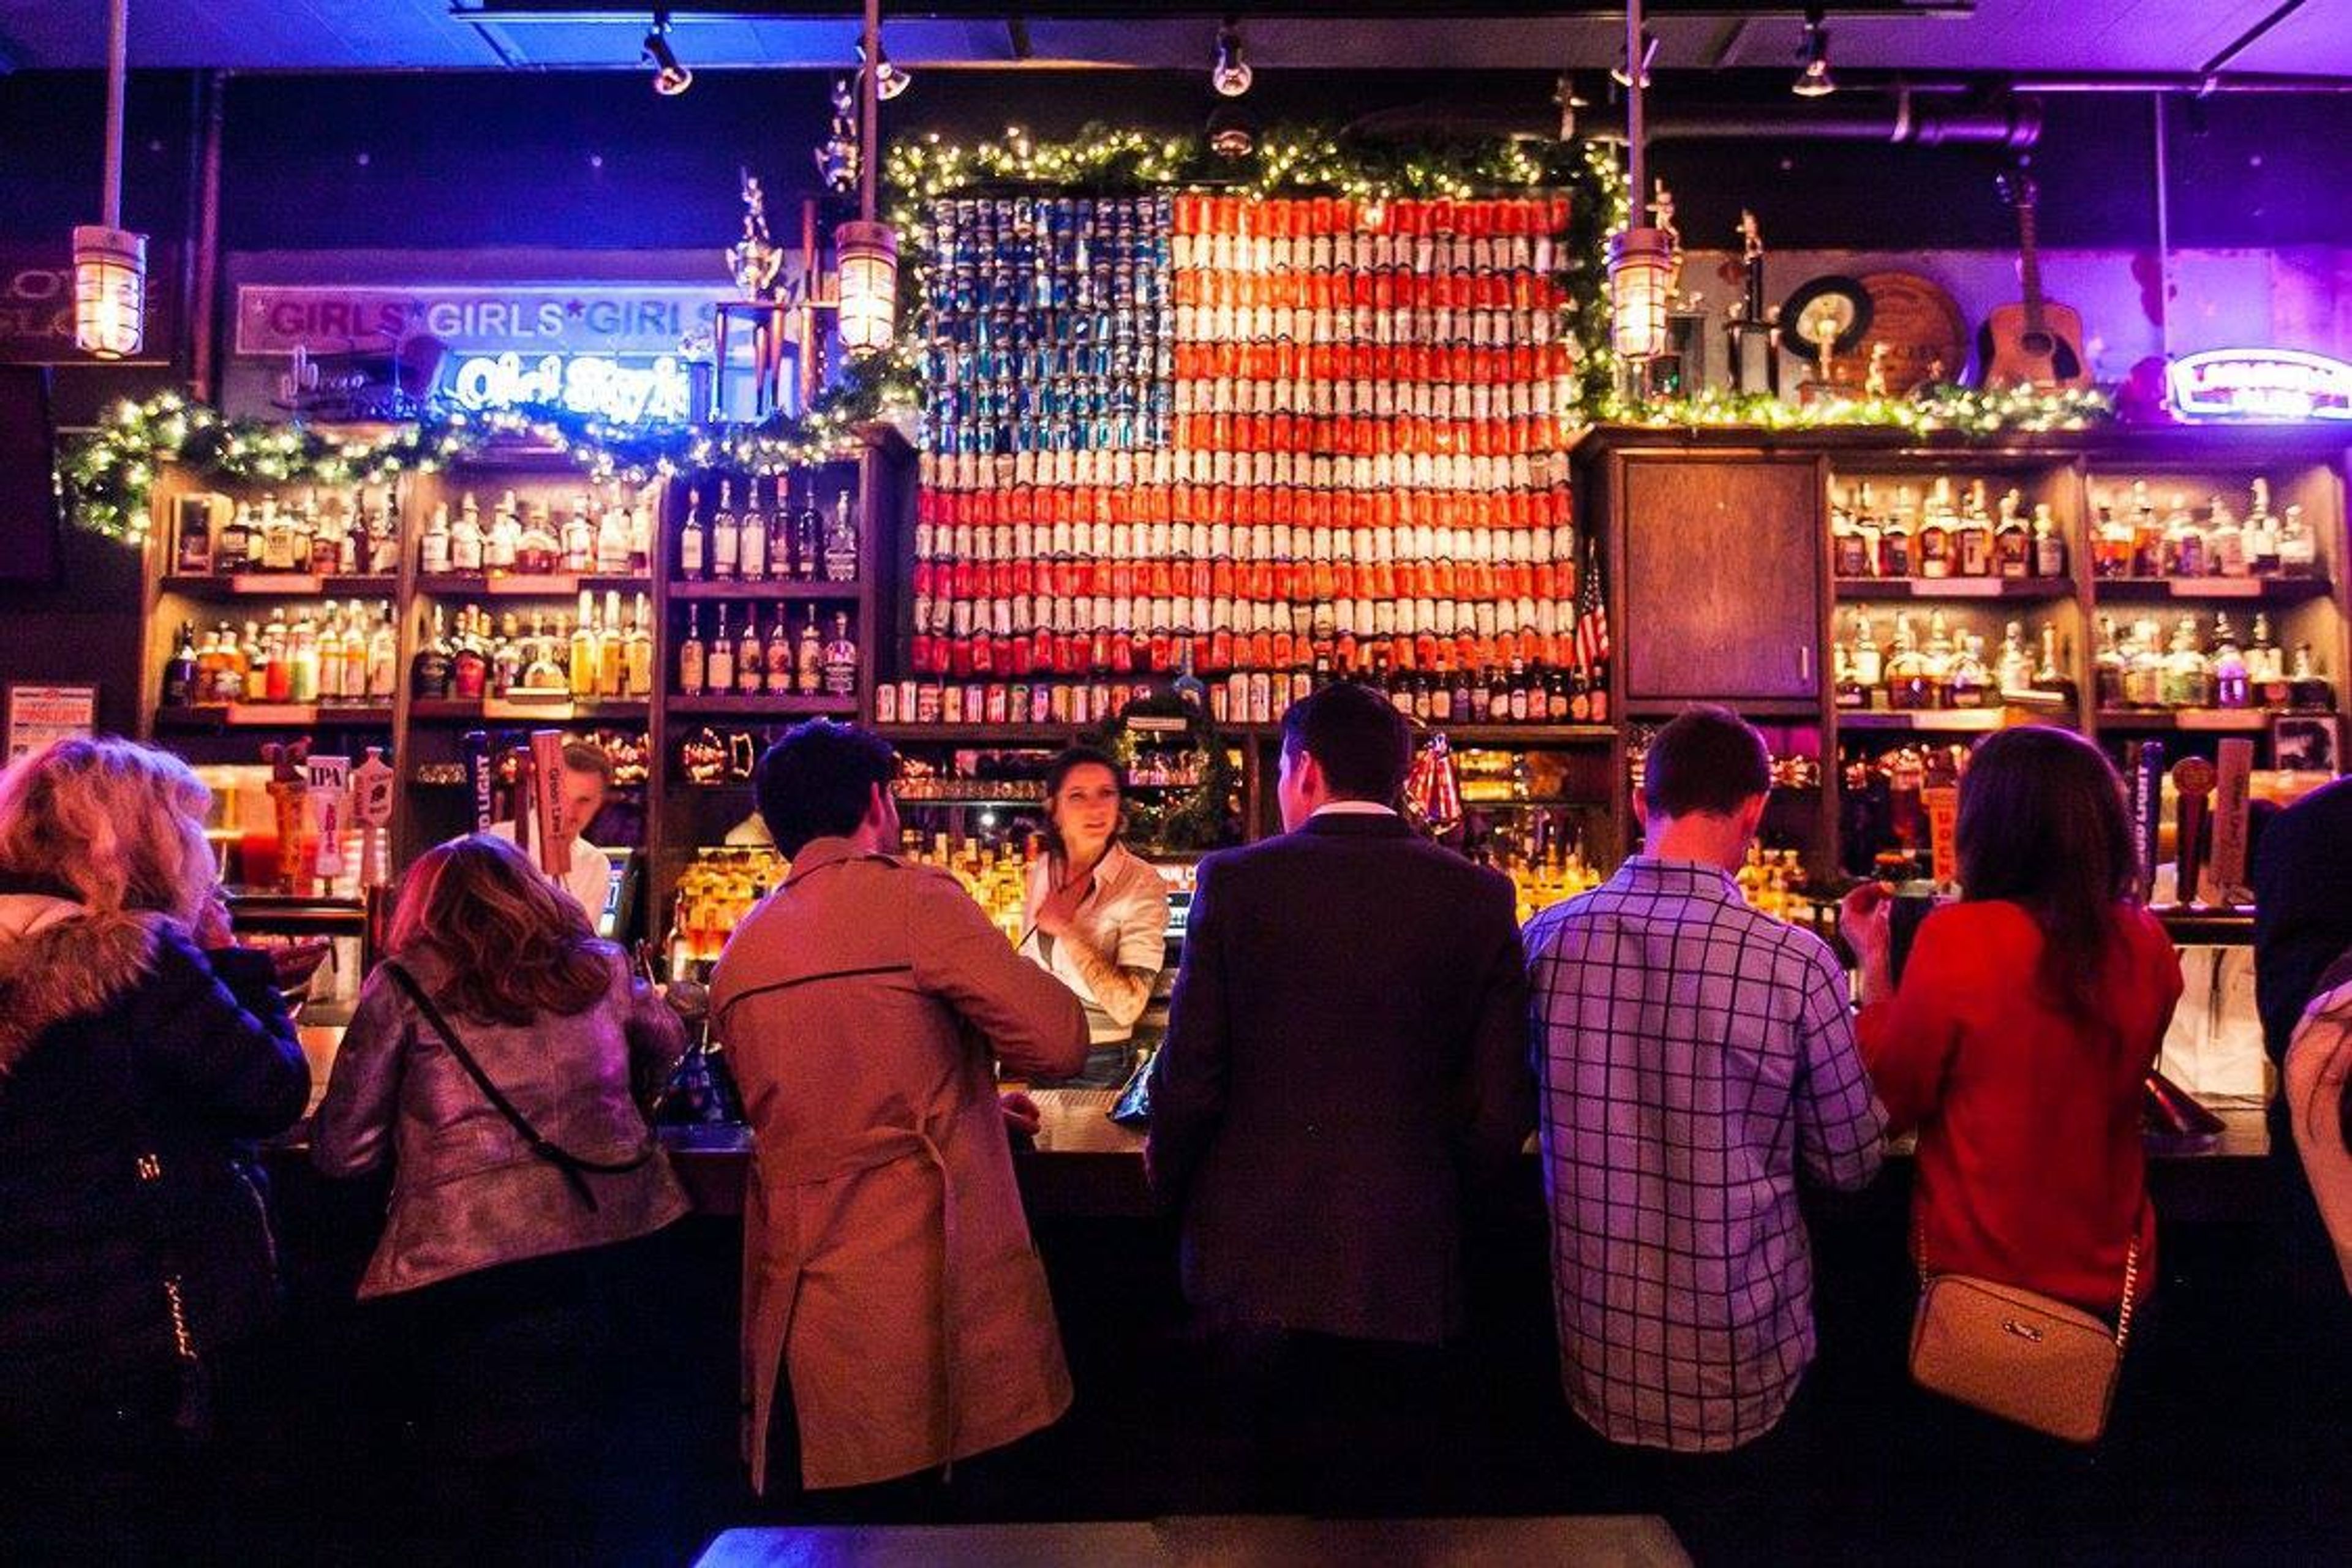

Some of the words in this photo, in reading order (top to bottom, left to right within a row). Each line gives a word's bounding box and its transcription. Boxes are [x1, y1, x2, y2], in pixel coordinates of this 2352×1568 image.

[271, 303, 405, 336] GIRLS
[429, 302, 564, 338] GIRLS
[311, 767, 341, 786] IPA
